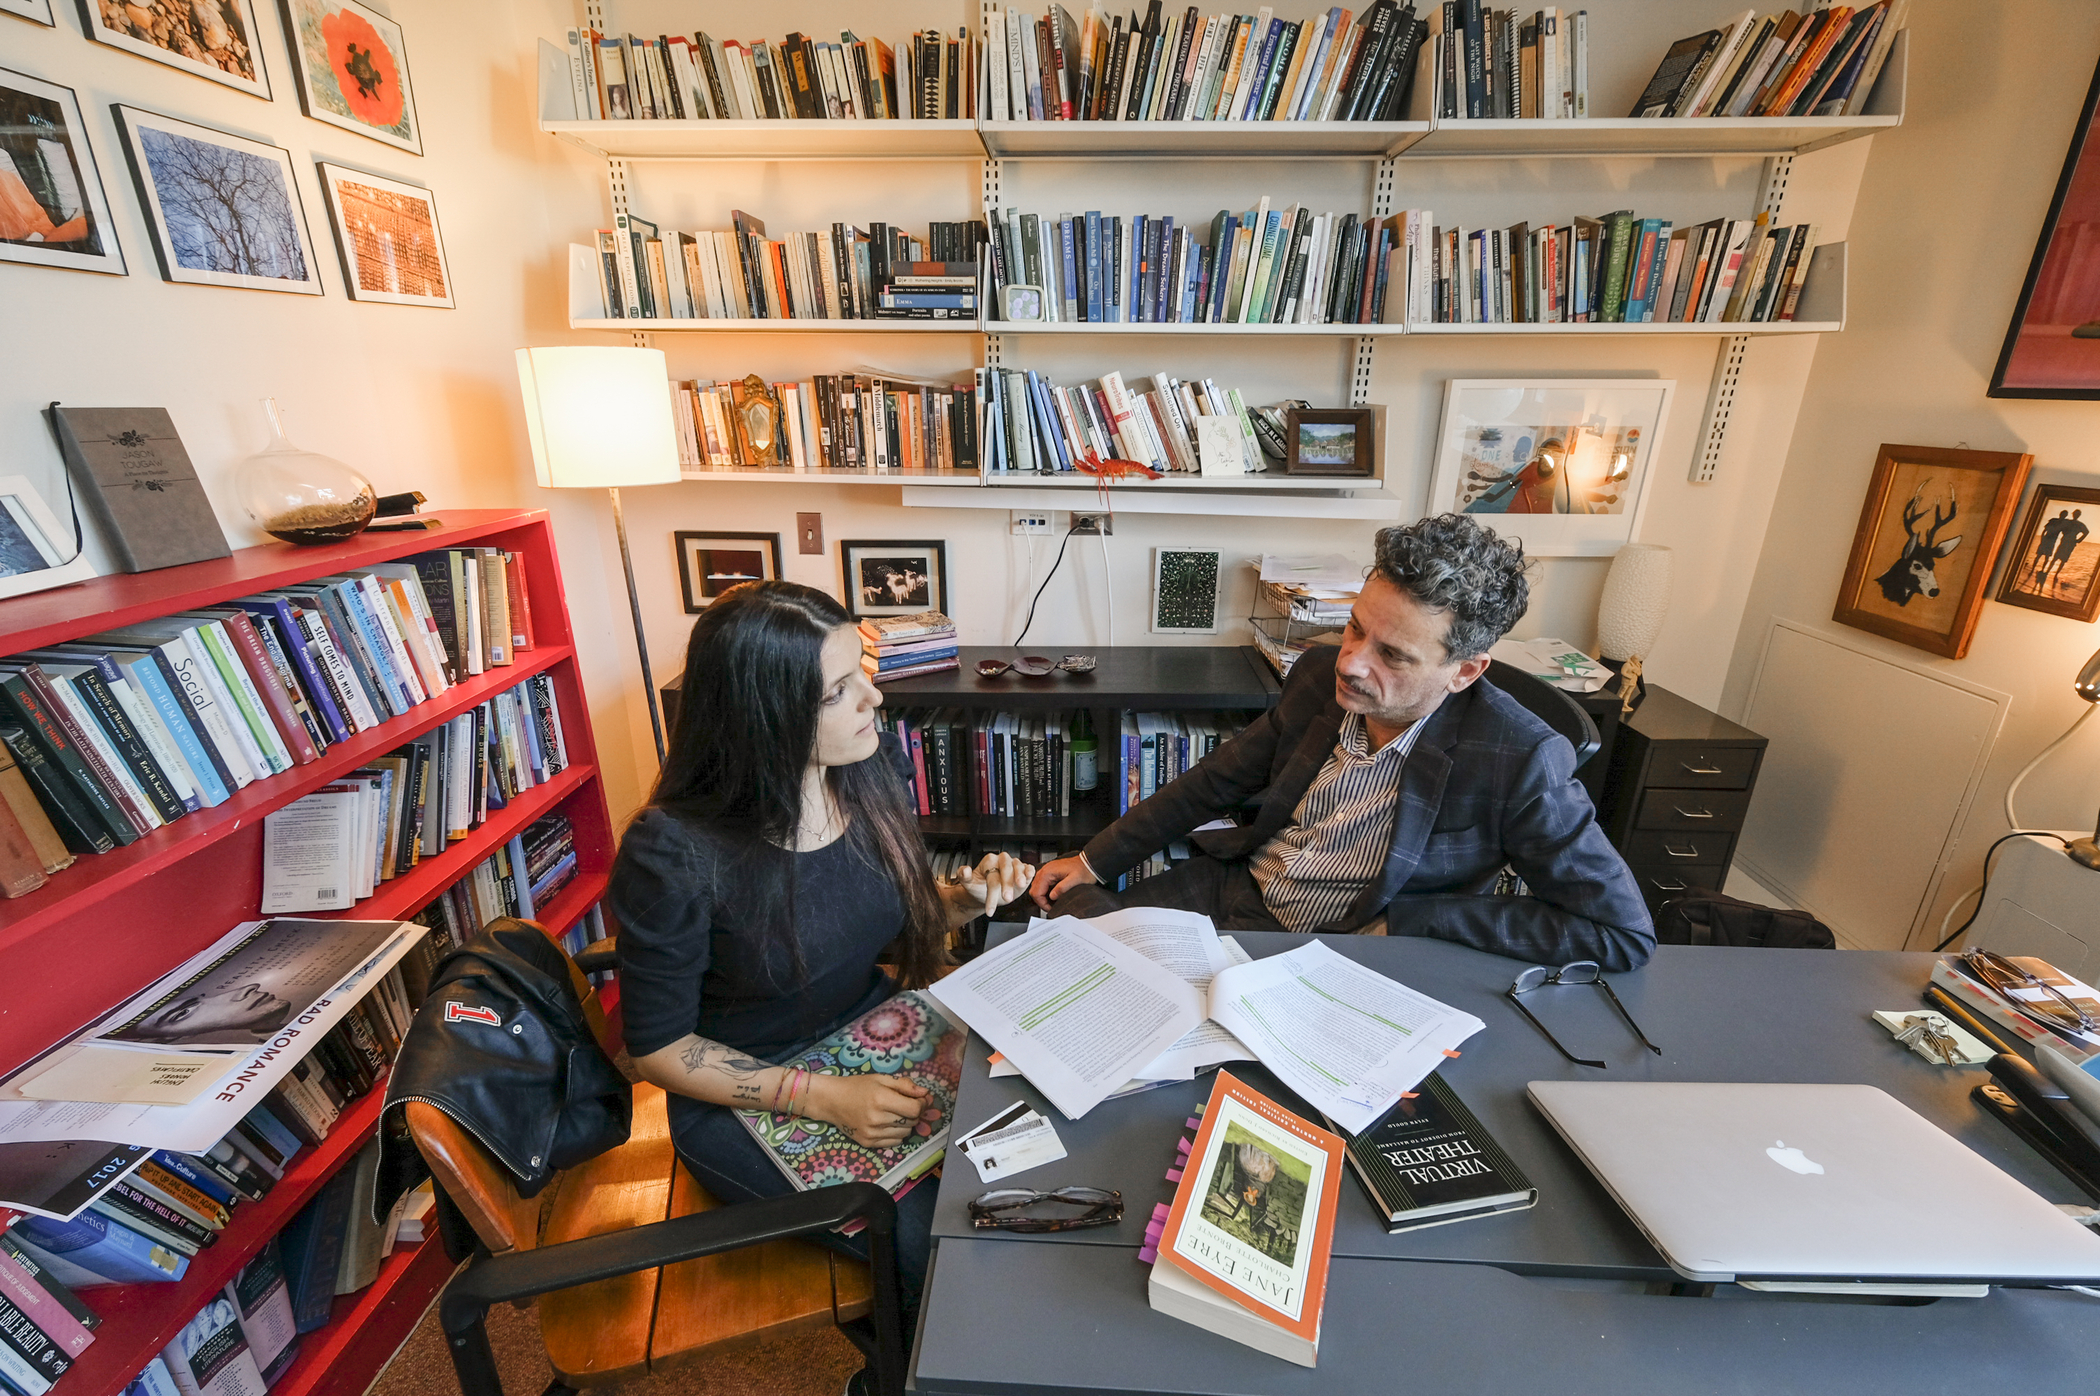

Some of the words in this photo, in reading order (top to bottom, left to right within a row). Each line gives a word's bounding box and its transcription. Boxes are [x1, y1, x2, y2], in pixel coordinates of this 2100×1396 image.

[1372, 8, 1384, 32] PINKER
[1378, 8, 1391, 34] STEVEN
[1178, 30, 1191, 63] TRAUMA
[1277, 25, 1297, 74] GENOME
[1470, 39, 1475, 47] OF
[1113, 41, 1125, 87] THERAPEUTIC
[1109, 89, 1117, 115] ACTION
[1169, 74, 1181, 104] DREAMS
[621, 230, 630, 253] GREAT
[1063, 223, 1072, 260] DREAMS
[1265, 216, 1280, 260] CONNECTOME
[1612, 220, 1624, 265] OVERTURN
[1620, 228, 1629, 251] LAKE
[1656, 241, 1665, 261] HEART
[624, 255, 636, 305] EXPECTATIONS
[1158, 276, 1166, 302] Seekers
[873, 388, 883, 432] Middlemarch
[1109, 377, 1125, 410] NeuroTribes
[1161, 384, 1178, 417] Switched
[1173, 418, 1182, 430] On
[239, 620, 249, 633] THE
[246, 633, 261, 655] DREAM
[257, 655, 279, 691] DRUGSTORE
[260, 626, 270, 641] The
[266, 641, 277, 655] End
[273, 655, 281, 663] of
[277, 663, 293, 689] Normal
[300, 647, 316, 675] Picturing
[314, 626, 326, 644] SELF
[323, 644, 339, 670] COMES
[336, 670, 345, 681] TO
[341, 681, 355, 701] MIND
[175, 657, 215, 712] Social
[16, 690, 37, 713] HOW
[32, 711, 48, 727] WE
[43, 725, 67, 752] THINK
[86, 675, 95, 684] In
[91, 682, 110, 706] Search
[106, 705, 115, 714] of
[111, 713, 133, 740] Memory
[141, 666, 161, 694] BEYOND
[158, 694, 183, 733] HUMAN
[180, 733, 199, 760] NATURE
[139, 759, 152, 774] Eric
[148, 773, 157, 782] R.
[153, 781, 172, 804] Kandel
[938, 738, 948, 804] ANXIOUS
[215, 1029, 301, 1103] ROMANCE
[176, 1162, 198, 1180] Culture
[1383, 1140, 1481, 1167] THEATER
[1400, 1158, 1493, 1185] VIRTUAL
[87, 1157, 126, 1189] 2017
[158, 1173, 169, 1183] UP
[181, 1186, 201, 1203] START
[128, 1189, 144, 1204] FOR
[141, 1197, 156, 1211] THE
[154, 1204, 172, 1219] HELL
[169, 1212, 181, 1224] OF
[178, 1217, 188, 1228] IT
[1188, 1234, 1236, 1276] EYRE
[1236, 1246, 1290, 1283] CHARLOTTE
[1243, 1267, 1294, 1306] JANE
[21, 1324, 50, 1354] BEAUTY
